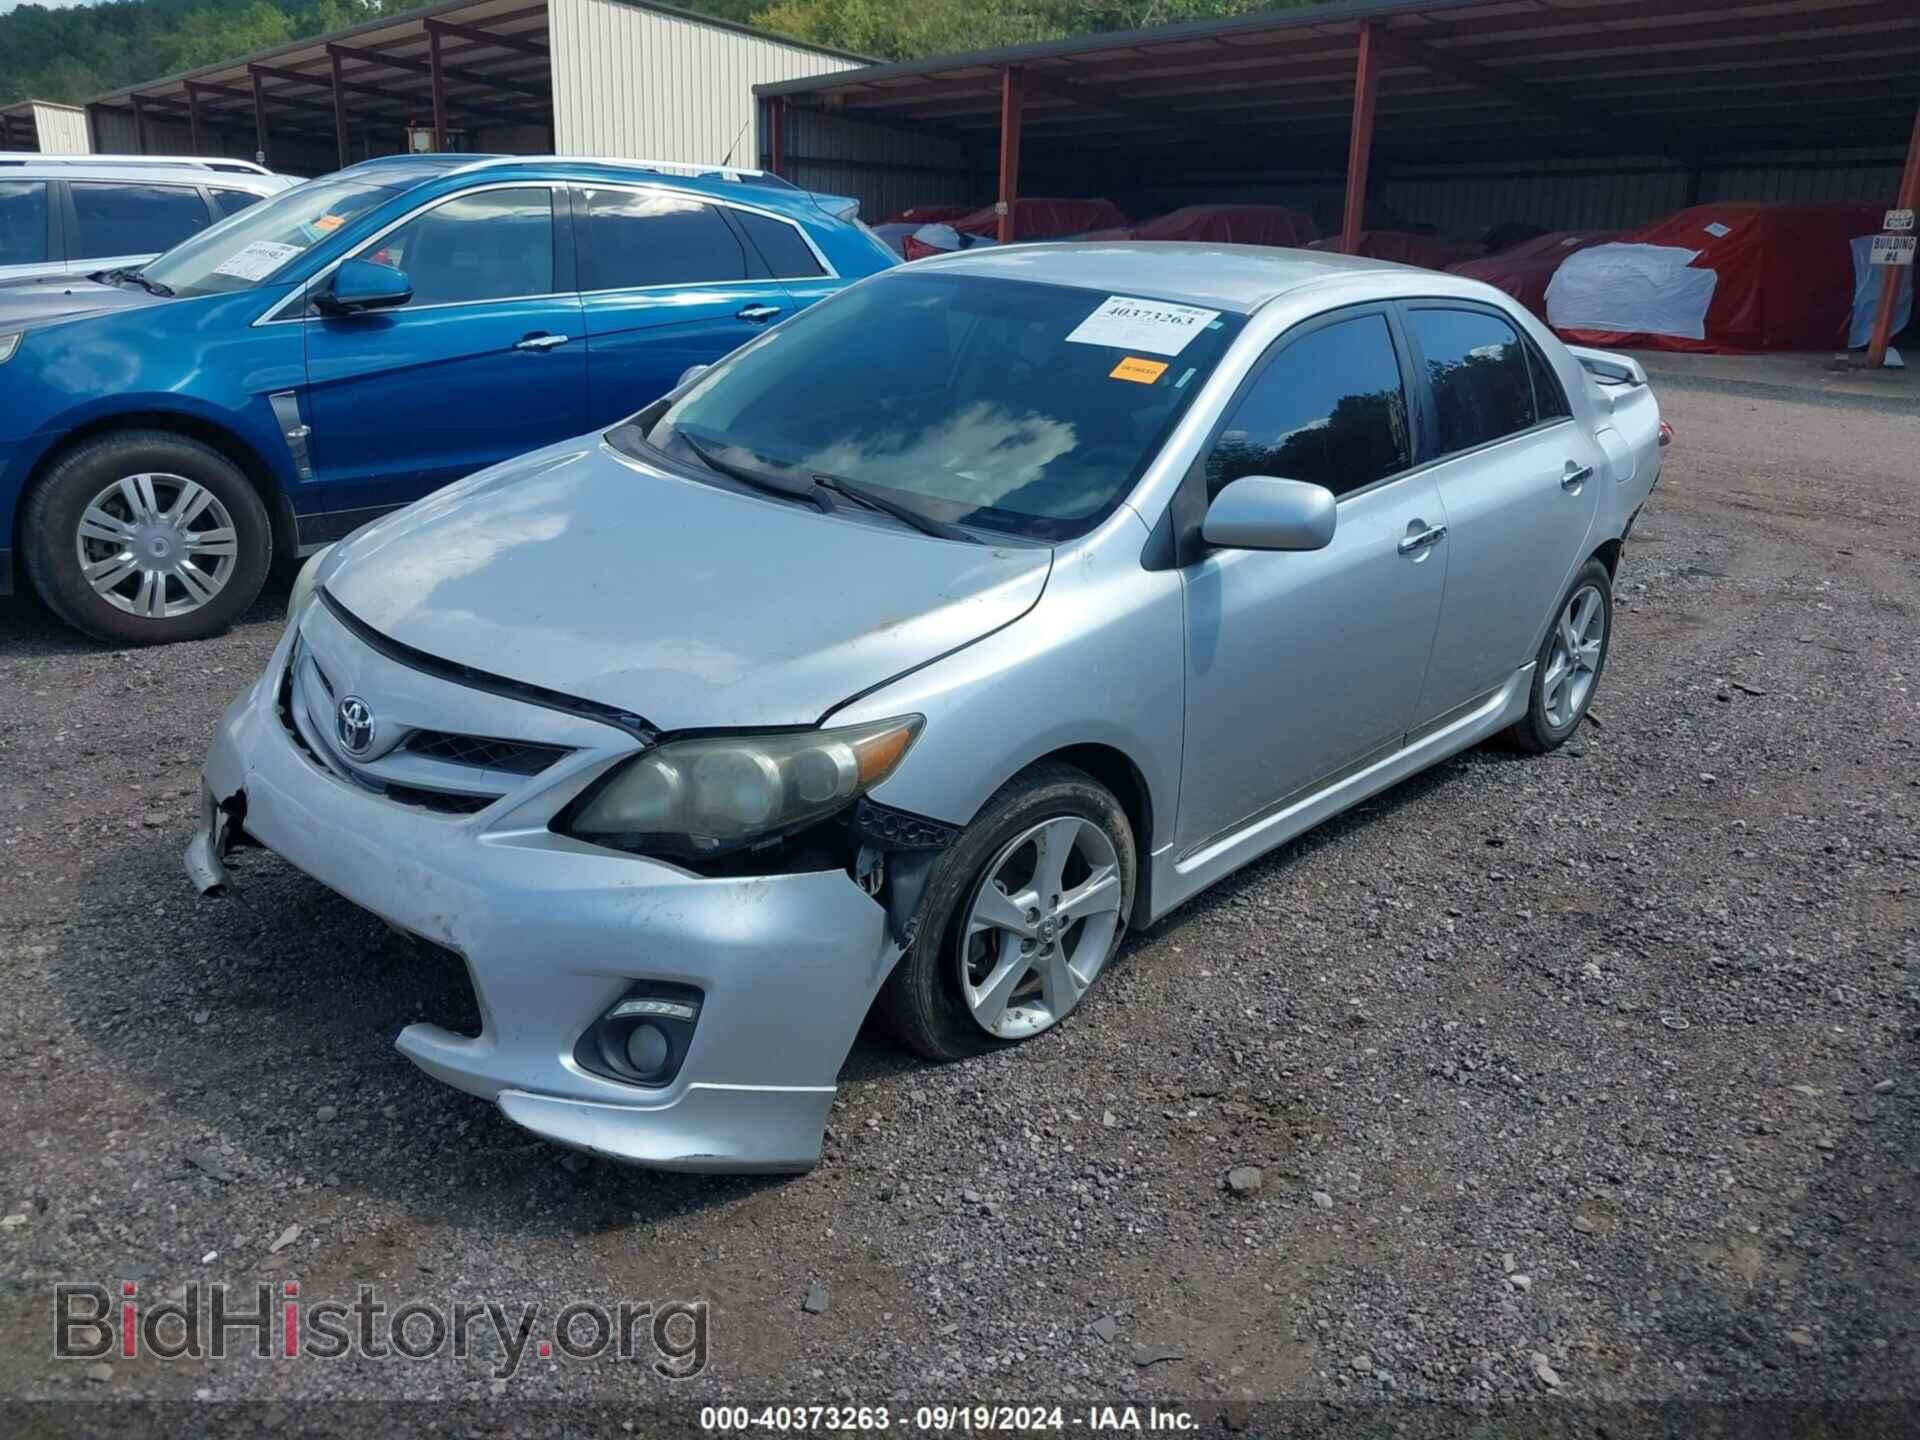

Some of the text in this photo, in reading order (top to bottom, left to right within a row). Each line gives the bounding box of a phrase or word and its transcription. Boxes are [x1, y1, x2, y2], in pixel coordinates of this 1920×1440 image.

[1874, 238, 1915, 250] BUILDING
[1884, 251, 1899, 262] #4
[1107, 306, 1195, 326] 40373263
